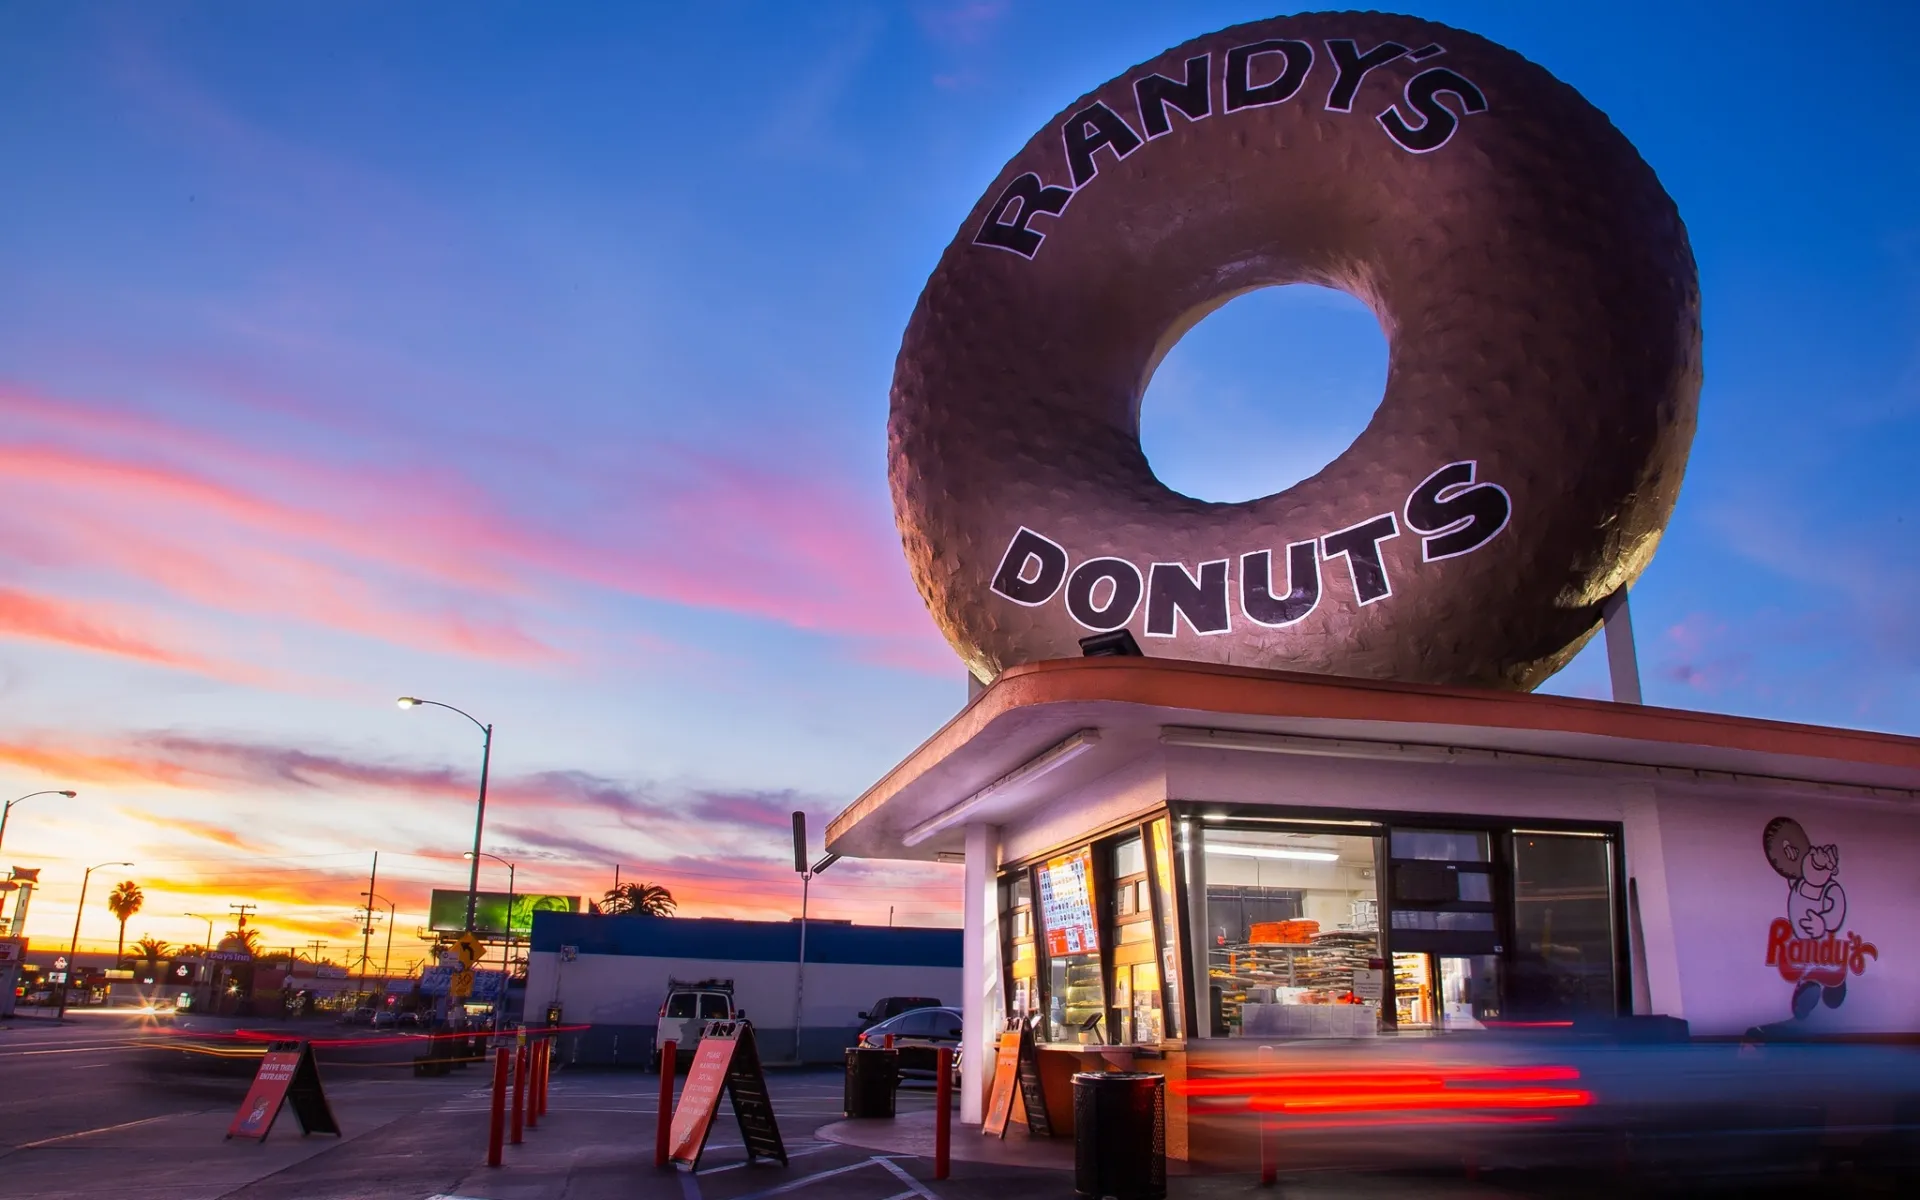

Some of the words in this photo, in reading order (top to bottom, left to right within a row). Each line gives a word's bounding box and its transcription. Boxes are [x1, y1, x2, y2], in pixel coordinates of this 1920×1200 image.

[972, 38, 1488, 260] RANDY'S
[989, 459, 1512, 639] DONUTS
[1765, 917, 1878, 987] Randy's
